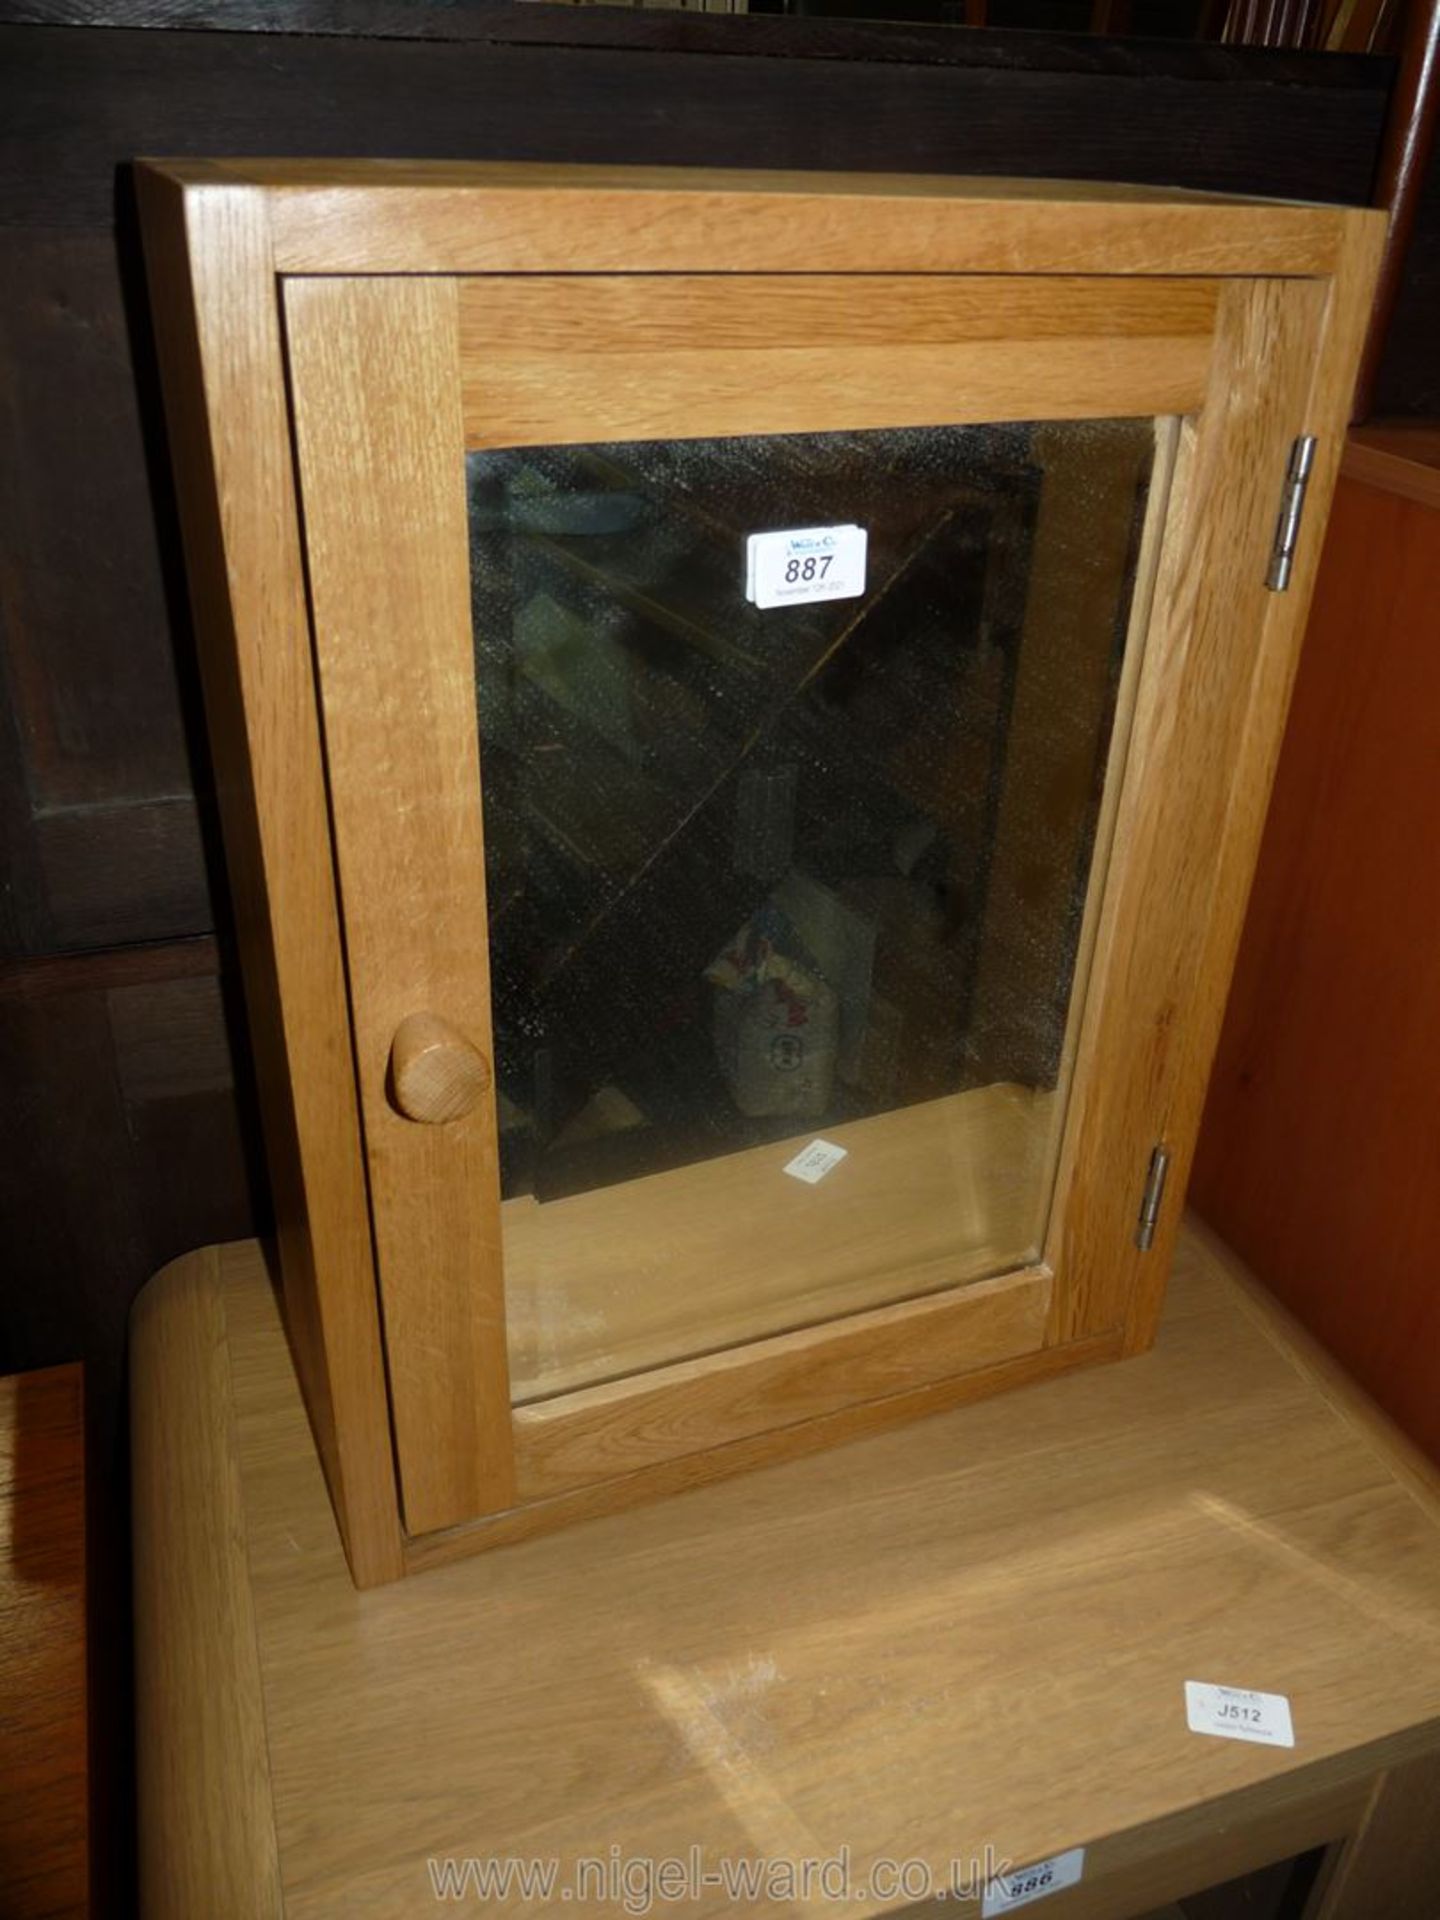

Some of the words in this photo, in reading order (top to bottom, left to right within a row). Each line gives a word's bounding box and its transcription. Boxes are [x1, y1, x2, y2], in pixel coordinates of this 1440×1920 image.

[785, 555, 833, 583] 887
[1217, 1704, 1262, 1723] J512
[1011, 1870, 1054, 1898] 886
